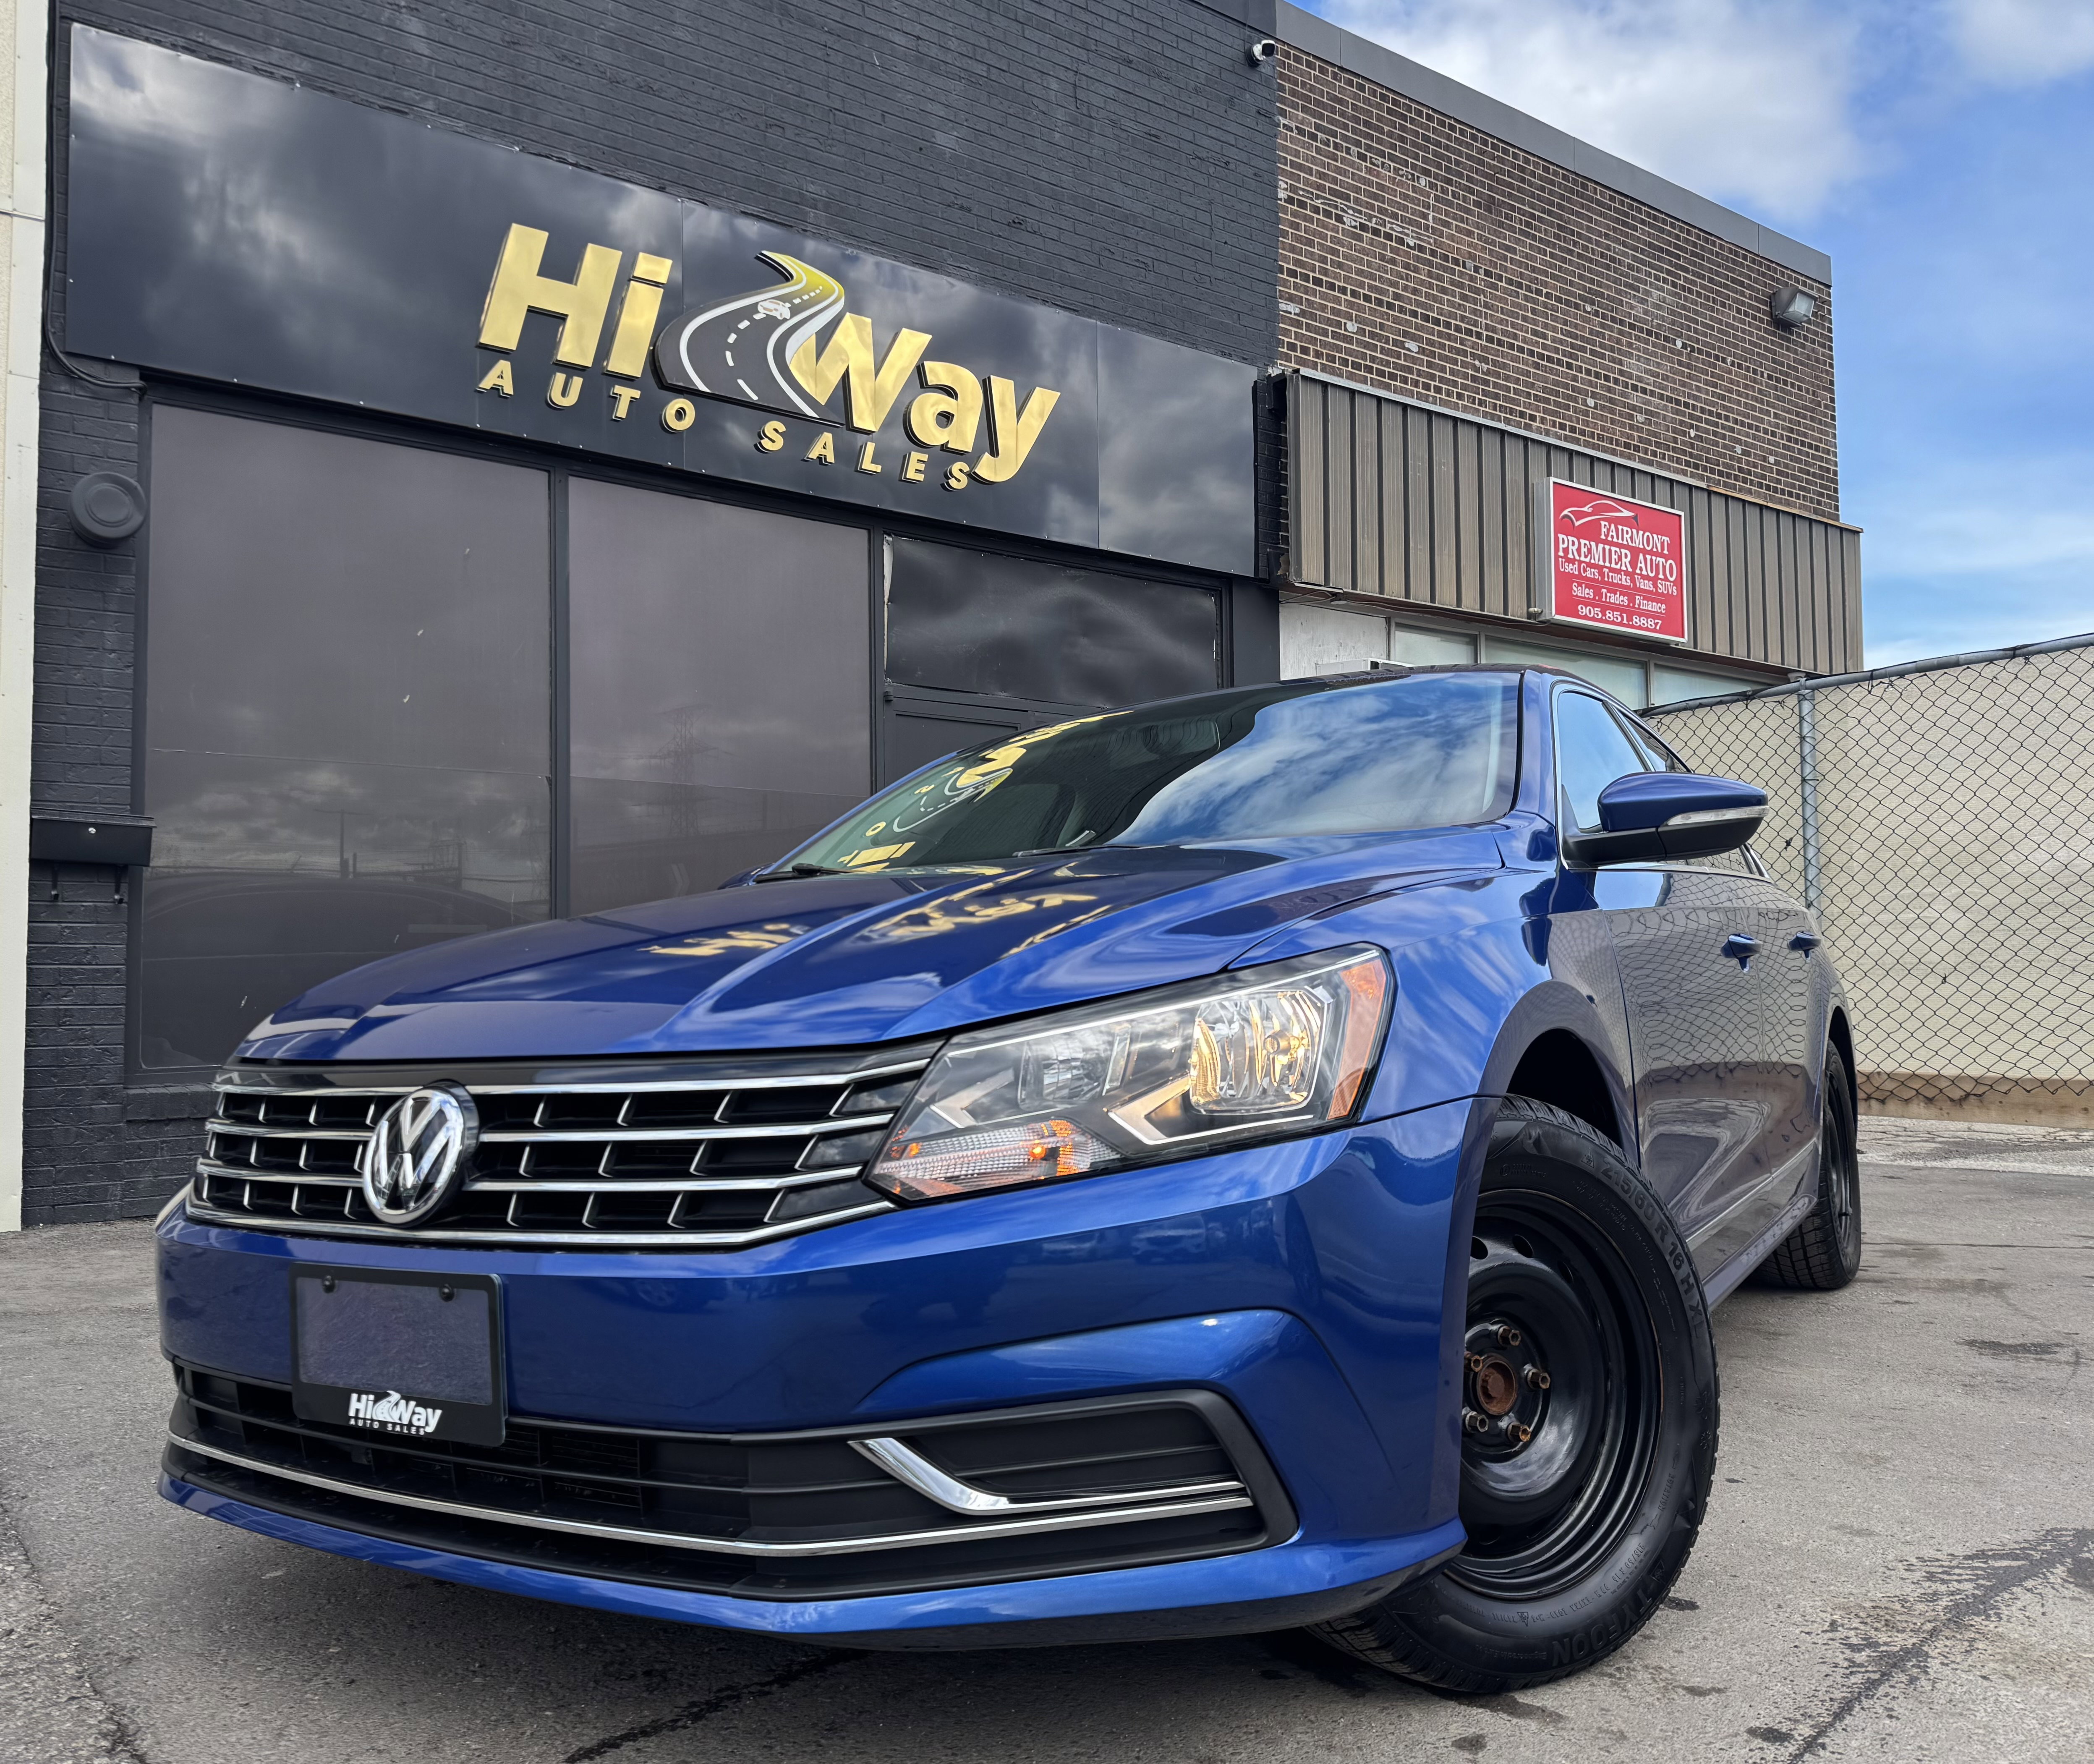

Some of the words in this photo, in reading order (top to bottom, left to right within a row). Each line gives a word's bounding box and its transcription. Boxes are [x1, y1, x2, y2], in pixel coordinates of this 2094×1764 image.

[477, 359, 695, 432] AUTO
[756, 421, 970, 491] SALES
[1600, 520, 1670, 555] FAIRMONT
[1557, 533, 1632, 572] PREMIER
[1635, 553, 1677, 581] AUTO
[1558, 558, 1579, 575] Used
[1580, 562, 1601, 581] Cars,
[1603, 568, 1633, 588] Trucks,
[1634, 575, 1655, 592] Vans,
[1657, 582, 1677, 596] SUVs
[1572, 583, 1594, 599] Sales
[1601, 590, 1628, 606] Trades
[1635, 596, 1666, 613] Finance
[1578, 604, 1662, 630] 905.851.8887
[1601, 1158, 1655, 1221] 215/60
[348, 1418, 379, 1429] AUTO
[387, 1423, 425, 1435] SALES
[1552, 1586, 1653, 1667] TYFOON
